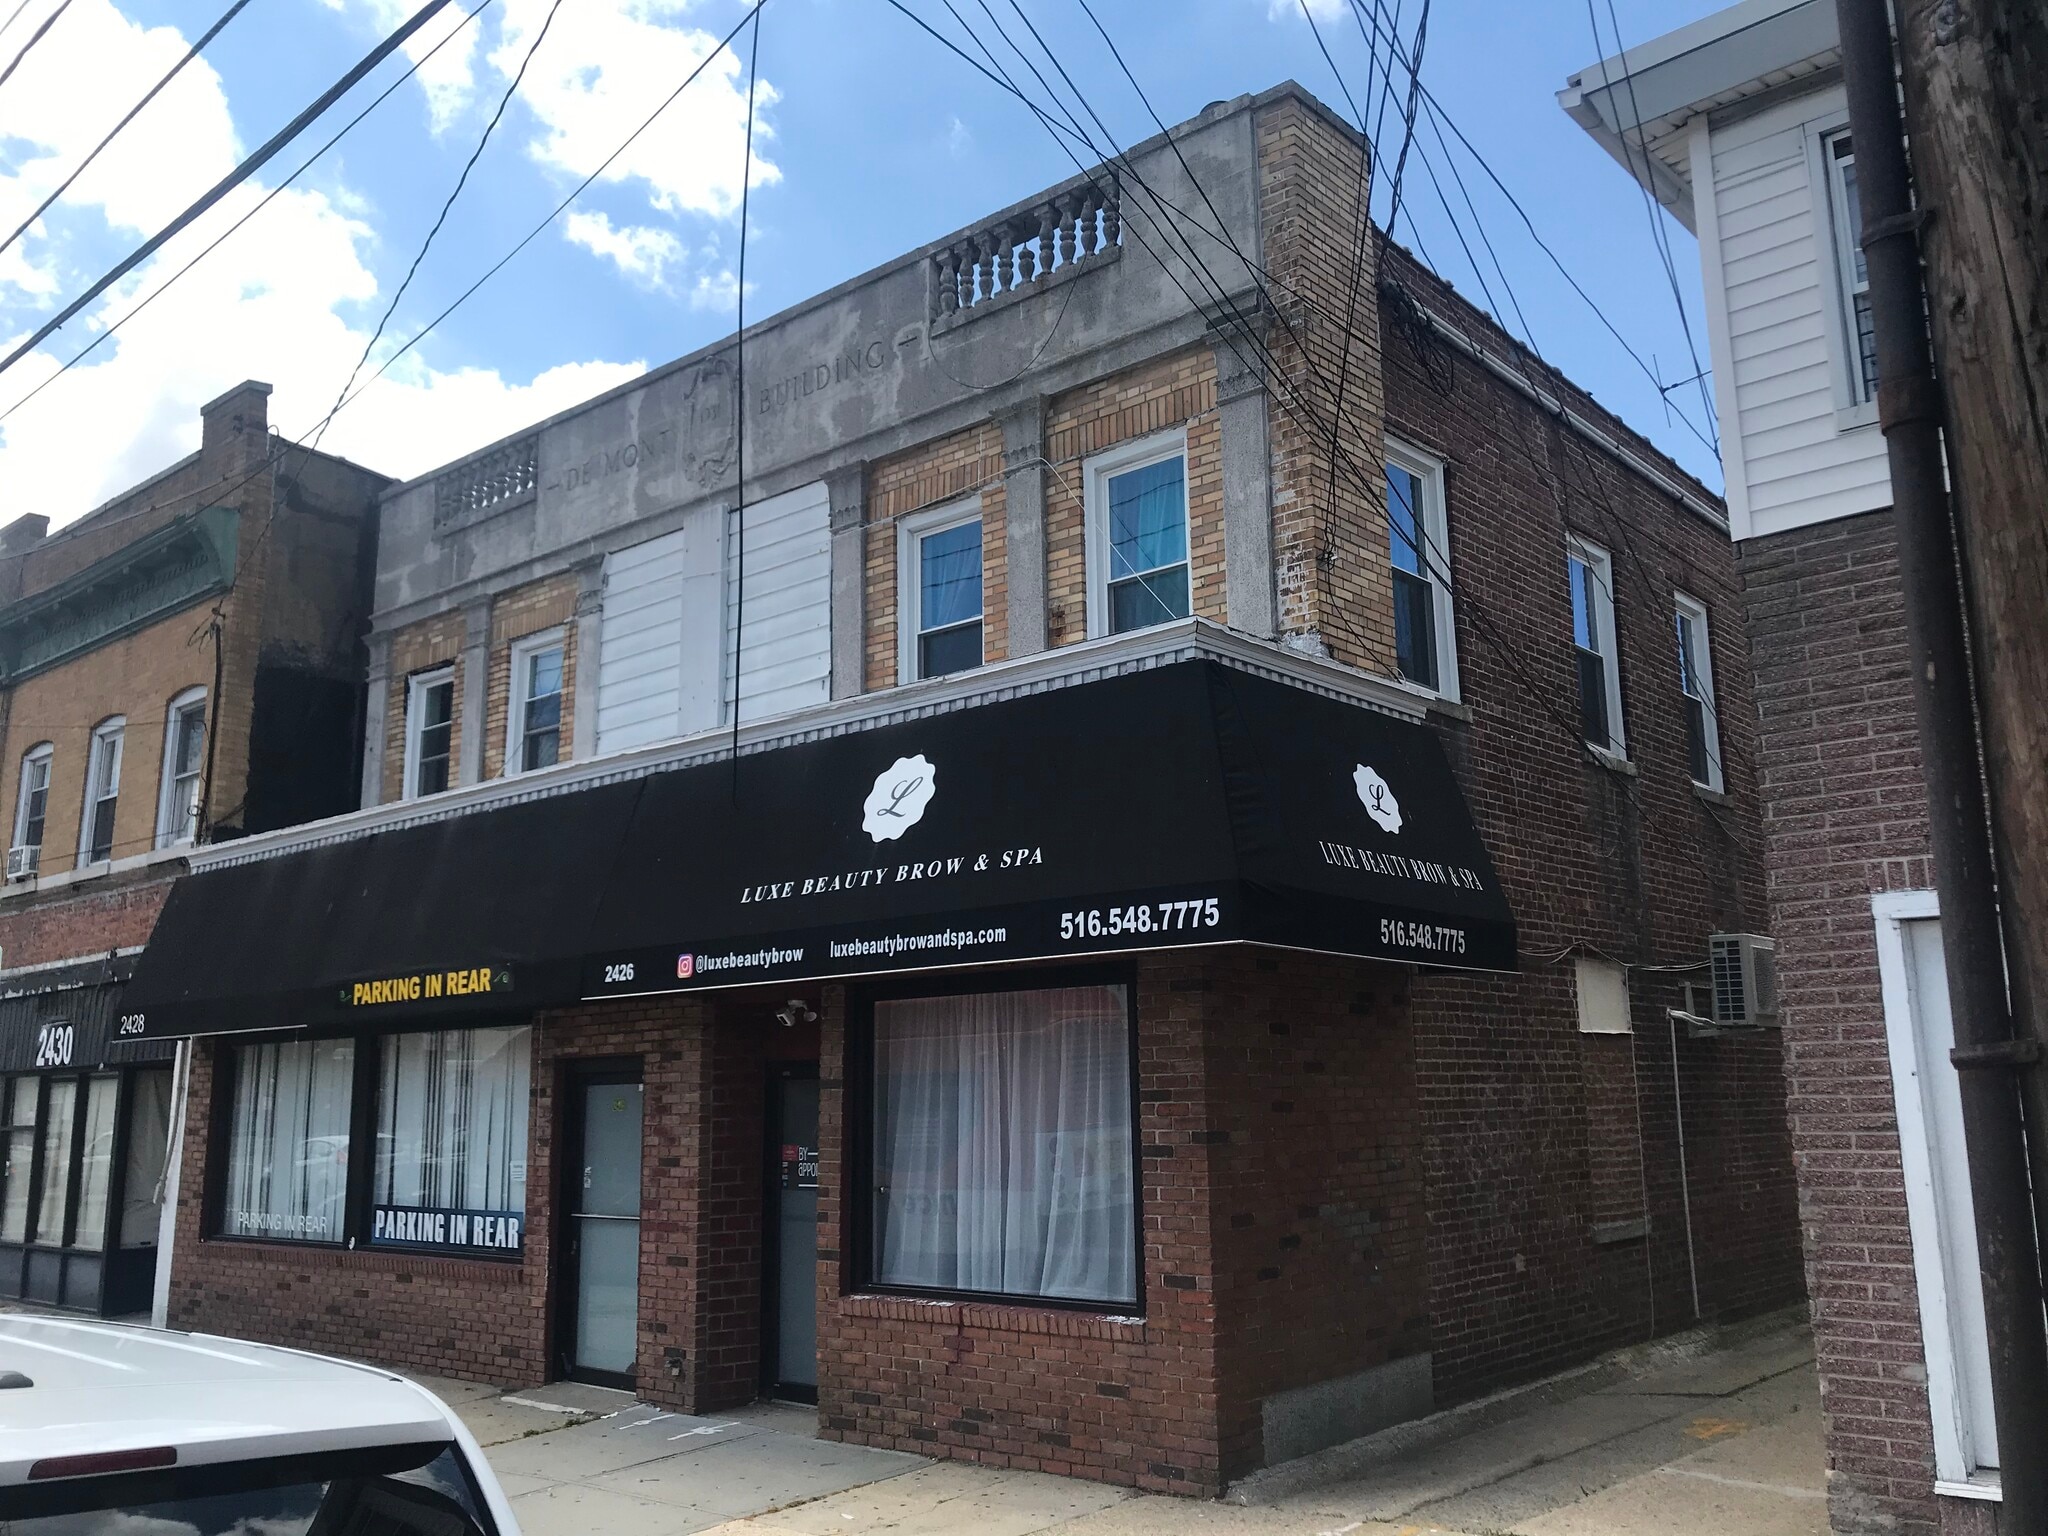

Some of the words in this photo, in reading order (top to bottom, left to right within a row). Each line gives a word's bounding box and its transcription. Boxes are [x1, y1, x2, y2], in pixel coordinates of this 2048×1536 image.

[760, 341, 884, 415] BUILDING
[566, 461, 592, 491] DE
[740, 881, 794, 903] LUXE
[800, 867, 889, 895] BEAUTY
[894, 857, 965, 882] BROW
[973, 853, 989, 871] &
[999, 847, 1043, 868] SPA
[1318, 840, 1360, 869] LUXE
[1357, 848, 1411, 879] BEAUTY
[1409, 858, 1448, 885] BROW
[1447, 865, 1461, 887] &
[1458, 867, 1484, 891] SPA
[1060, 897, 1220, 940] 516.548.7775
[1380, 918, 1465, 954] 516.548.7775
[830, 925, 1007, 959] luxebeautybrowandspa.com
[604, 963, 634, 983] 2426
[695, 947, 804, 974] @luxebeautybrow
[353, 976, 421, 1006] PARKING
[425, 974, 442, 998] IN
[446, 968, 491, 996] REAR
[120, 1014, 145, 1035] 2428
[36, 1025, 73, 1066] 2430
[799, 1147, 808, 1161] BY
[237, 1211, 281, 1230] PARKING
[285, 1215, 295, 1231] IN
[299, 1215, 327, 1233] REAR
[375, 1210, 445, 1243] PARKING
[449, 1214, 468, 1245] IN
[473, 1215, 519, 1249] REAR
